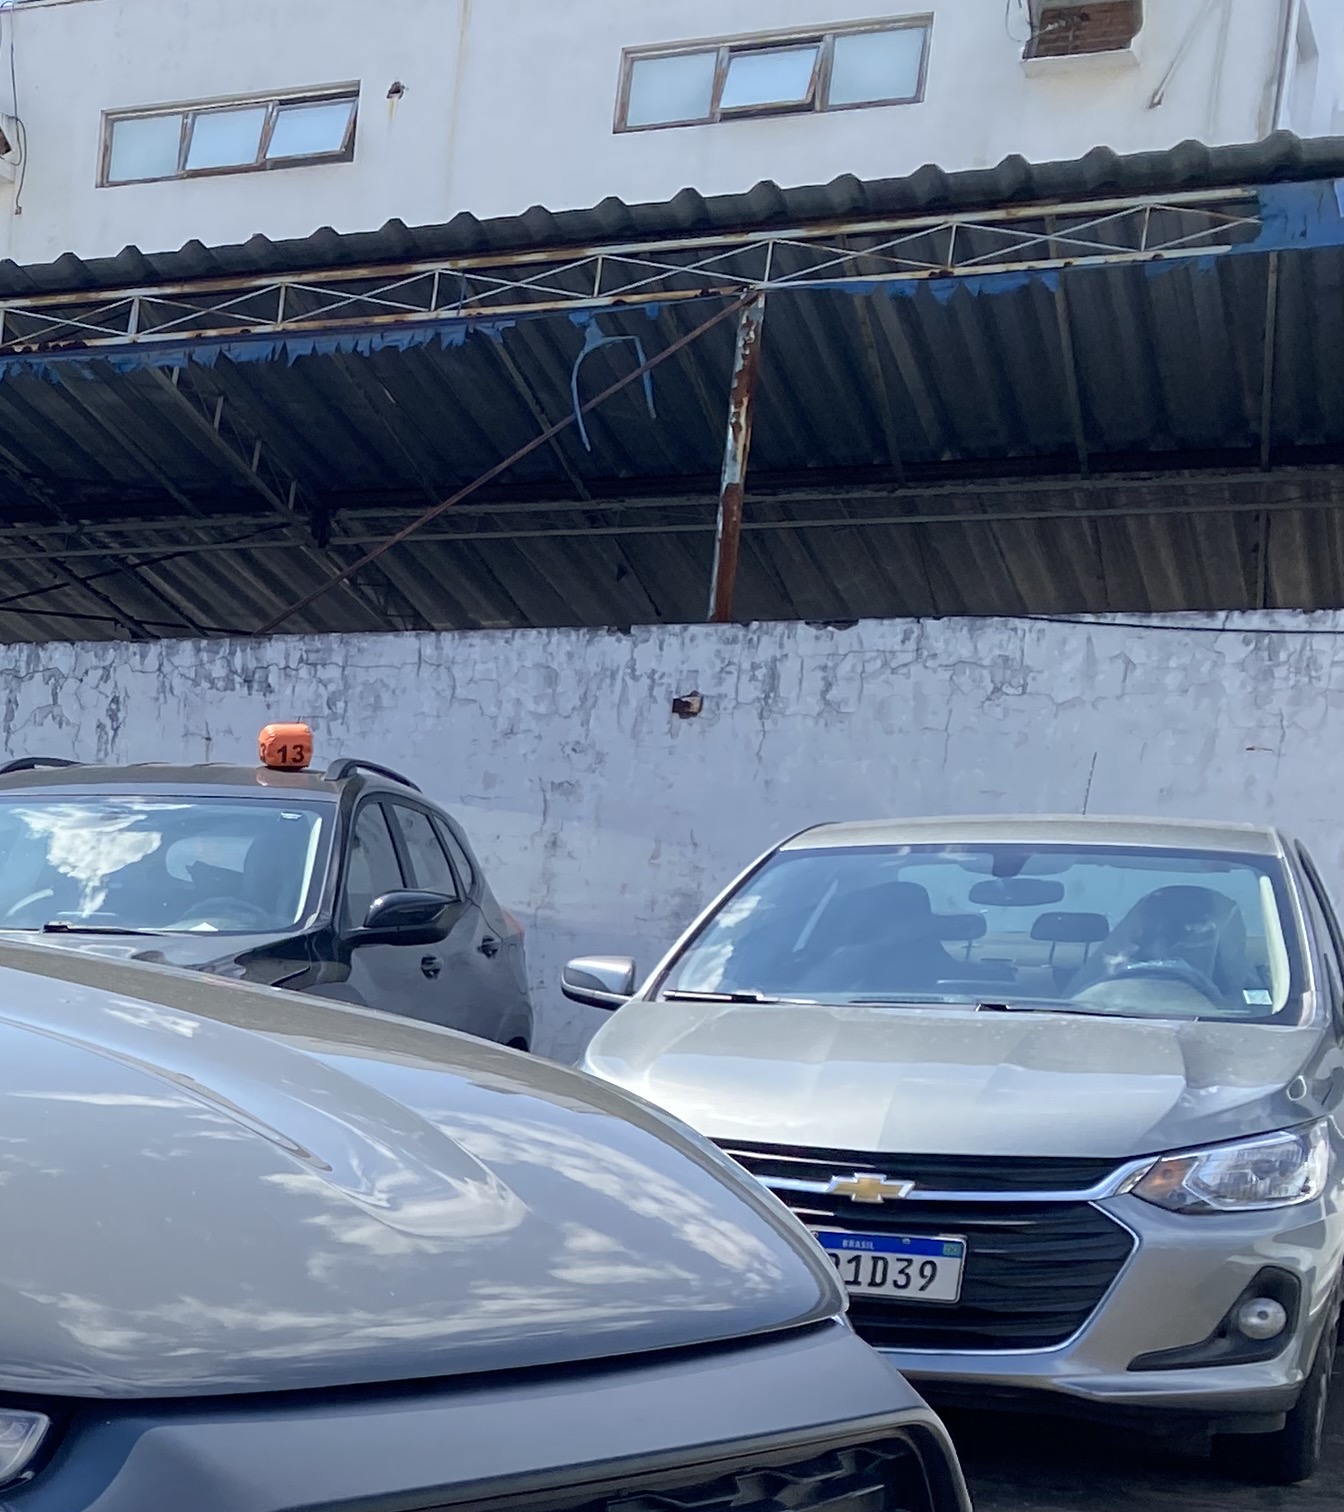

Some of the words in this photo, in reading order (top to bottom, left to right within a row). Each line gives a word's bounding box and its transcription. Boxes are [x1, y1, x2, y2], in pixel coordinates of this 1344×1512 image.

[277, 744, 305, 764] 13
[842, 1239, 875, 1250] BRASIL
[828, 1252, 938, 1291] 1D39
